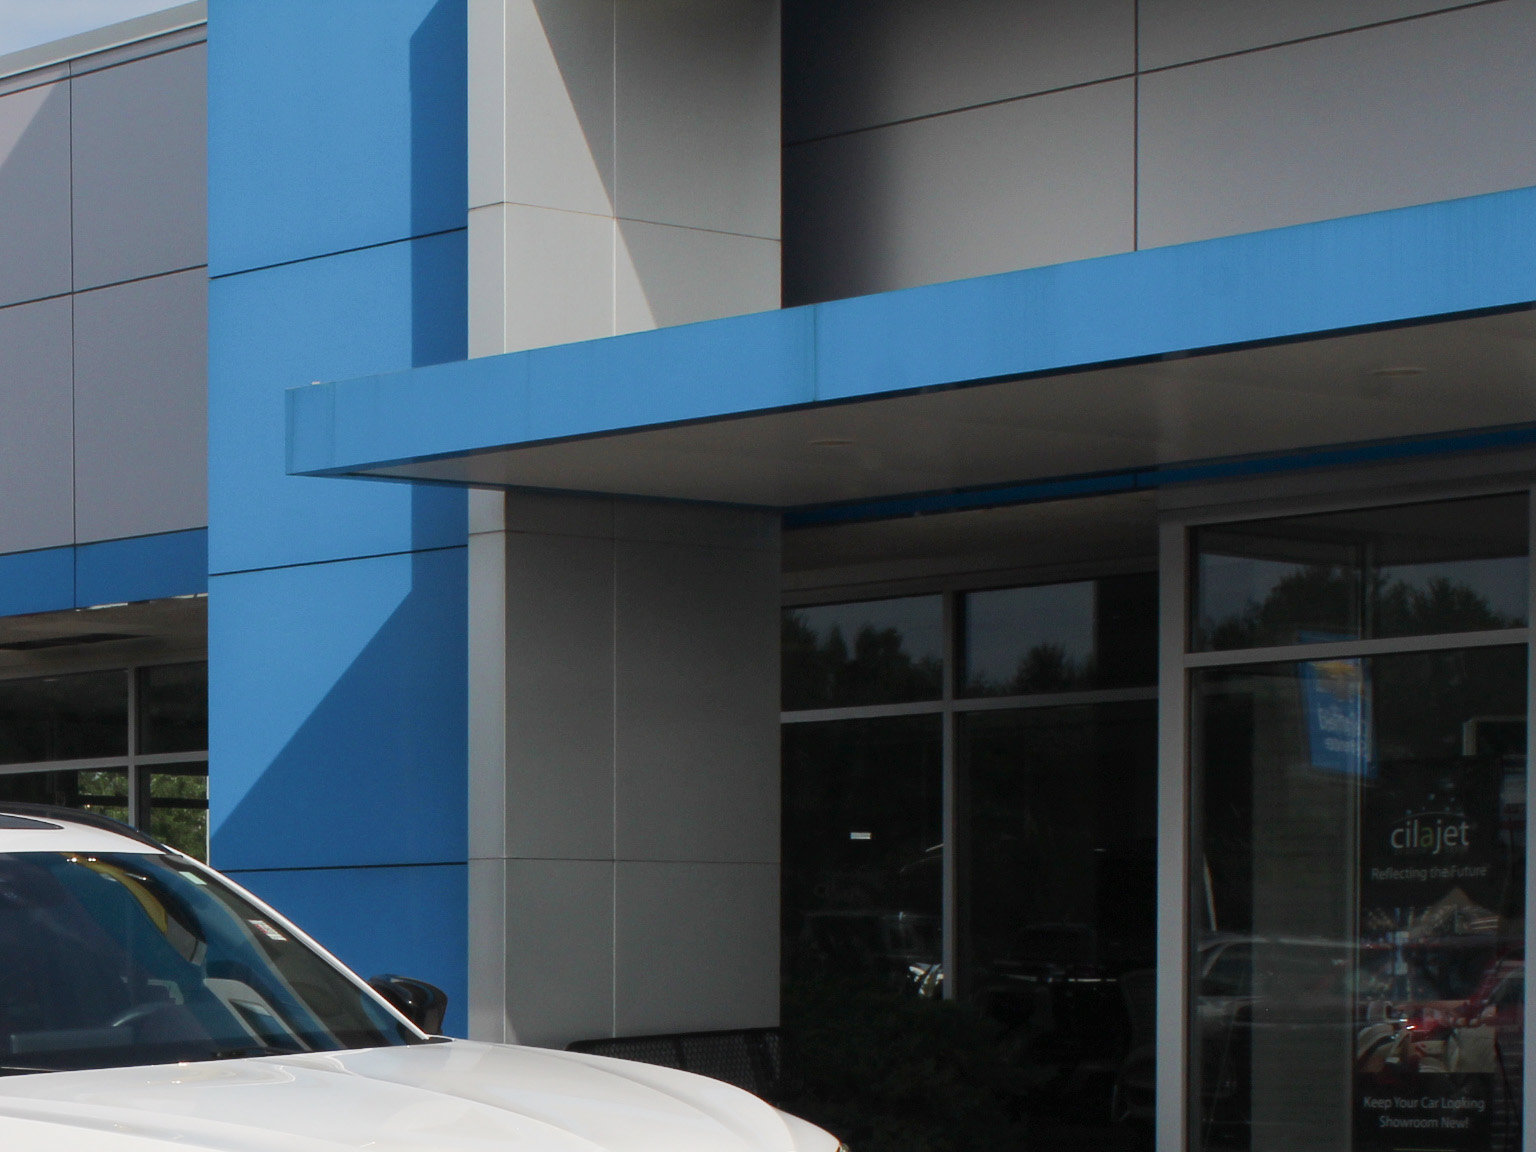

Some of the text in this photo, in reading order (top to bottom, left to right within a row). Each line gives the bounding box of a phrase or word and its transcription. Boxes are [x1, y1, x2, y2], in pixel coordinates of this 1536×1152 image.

[1390, 818, 1471, 856] cilajet
[1371, 865, 1488, 881] Reflecting the Future
[1364, 1096, 1485, 1112] Keep Your Car Looking
[1378, 1115, 1439, 1128] Showroom
